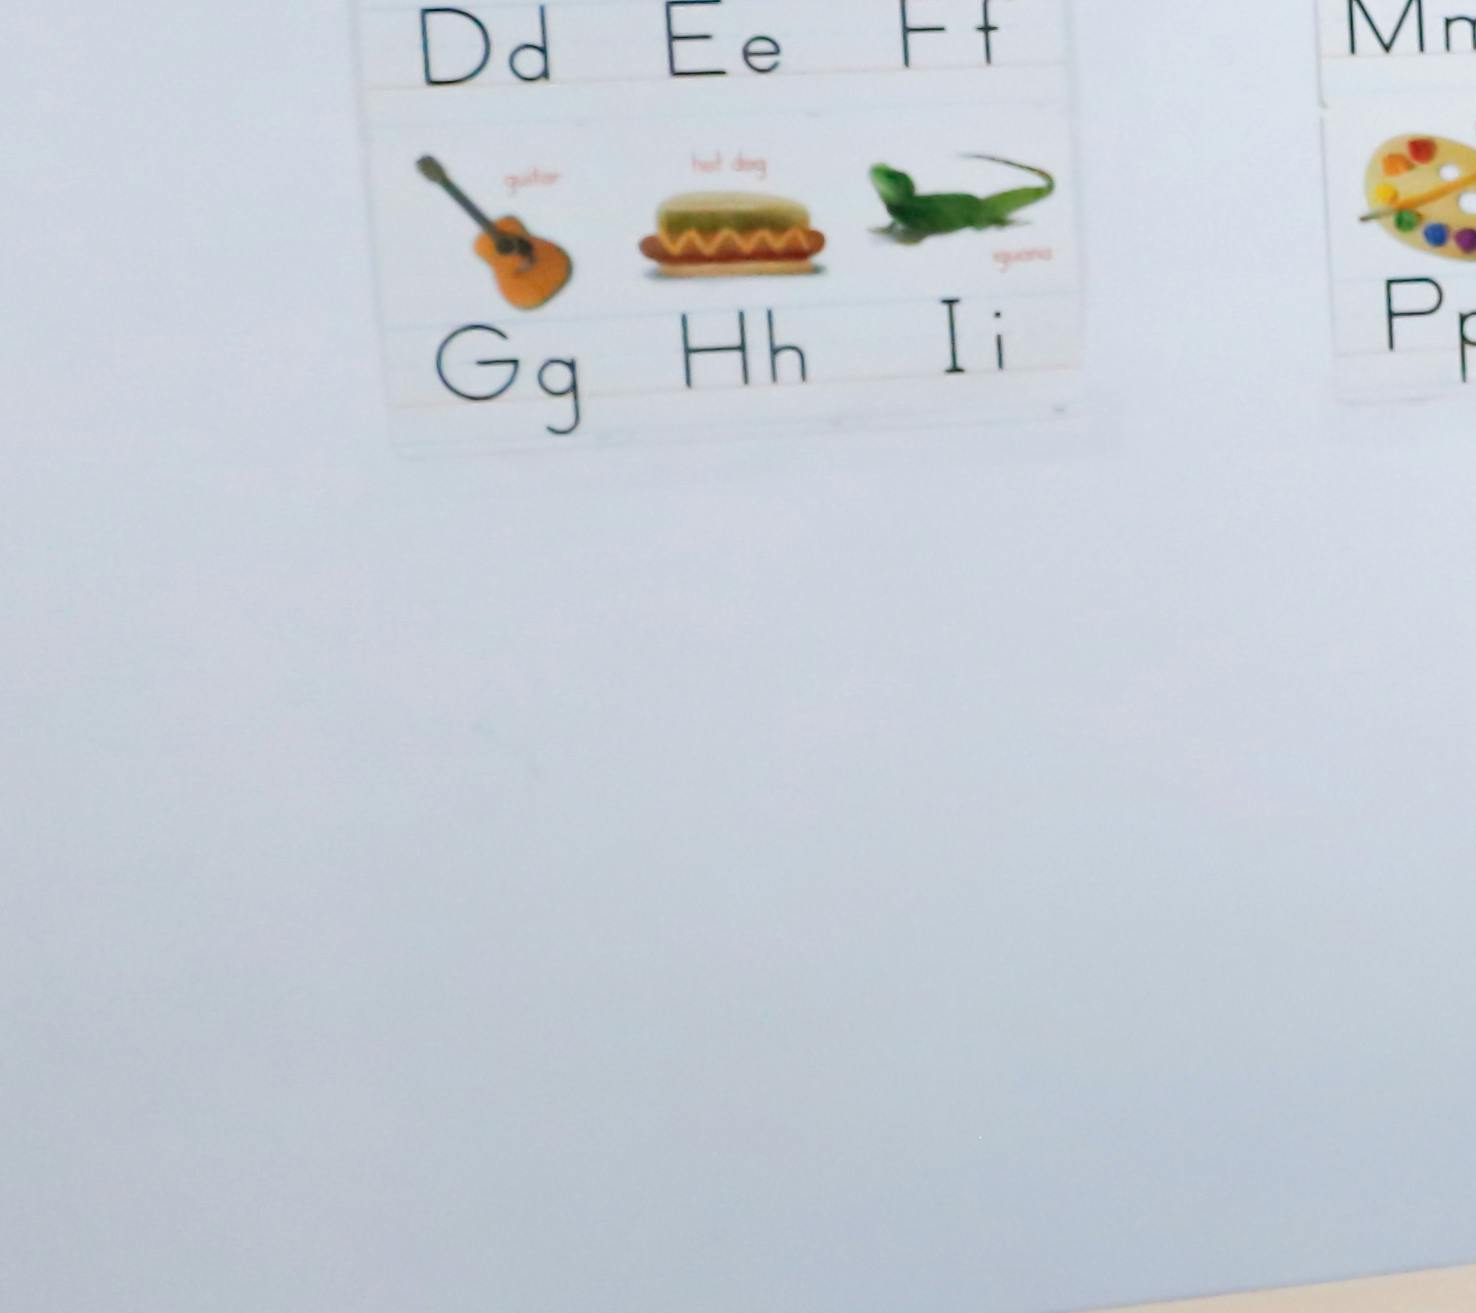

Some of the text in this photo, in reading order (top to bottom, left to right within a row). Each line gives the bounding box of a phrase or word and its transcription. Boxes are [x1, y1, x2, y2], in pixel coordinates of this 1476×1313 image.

[503, 165, 562, 196] guitar
[690, 150, 768, 181] hot dog
